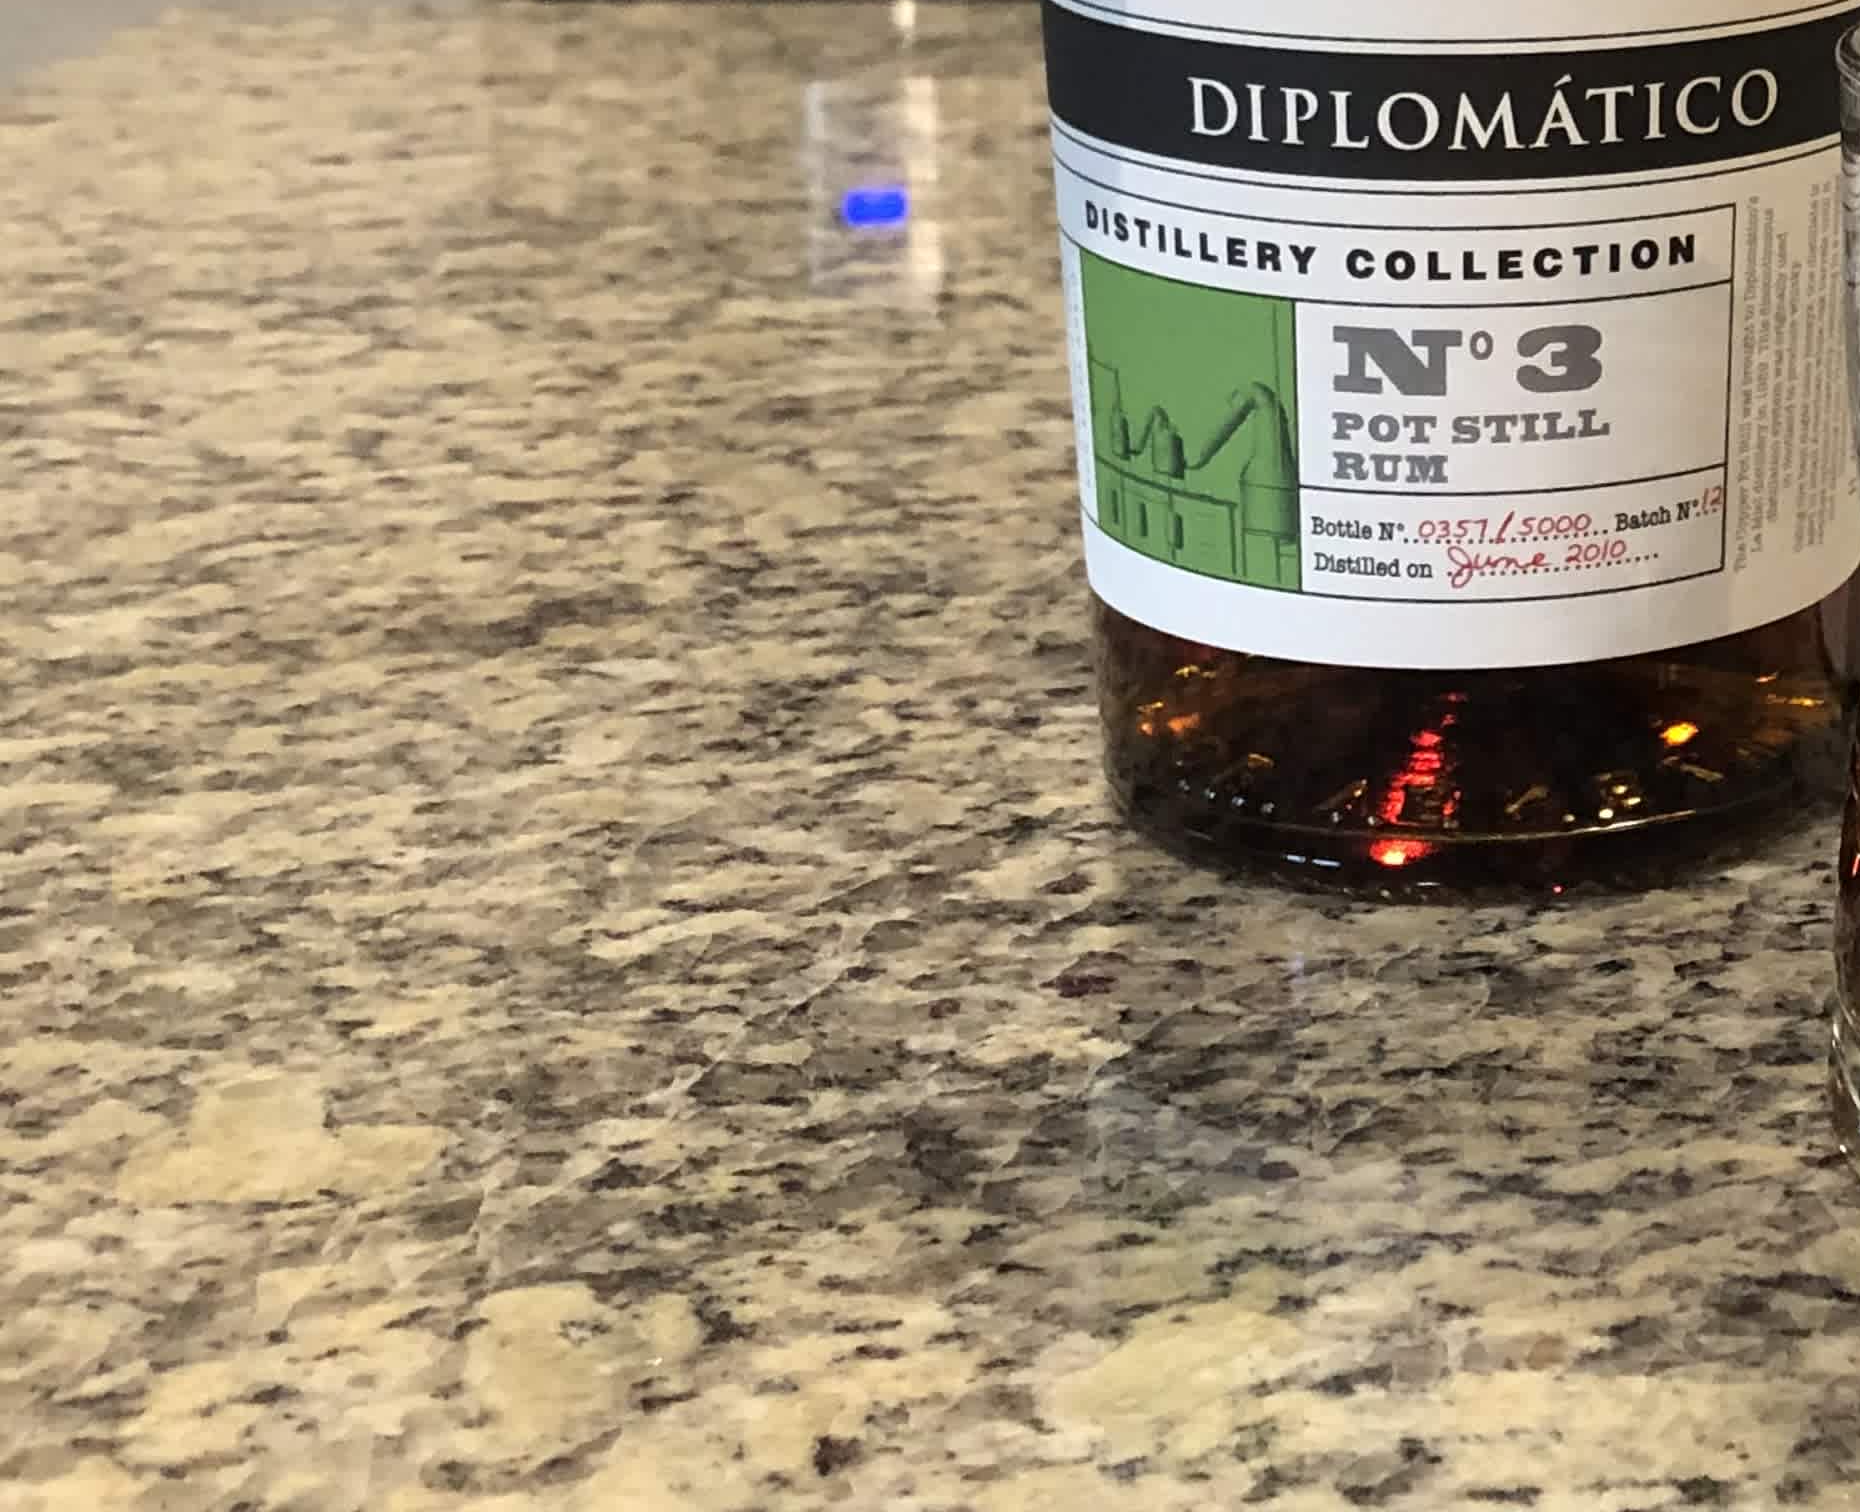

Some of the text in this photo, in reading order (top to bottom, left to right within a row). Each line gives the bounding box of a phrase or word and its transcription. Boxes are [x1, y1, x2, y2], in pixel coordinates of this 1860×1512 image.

[1187, 68, 1779, 153] DIPLOMÁTICO
[1084, 199, 1697, 281] DISTILLERY COLLECTION
[1515, 324, 1603, 394] 3
[1331, 407, 1611, 445] POT STILL
[1331, 451, 1449, 484] RUM
[1310, 515, 1372, 541] Bottle
[1613, 507, 1672, 533] Batch
[1313, 538, 1627, 589] Distilled on June 2010
